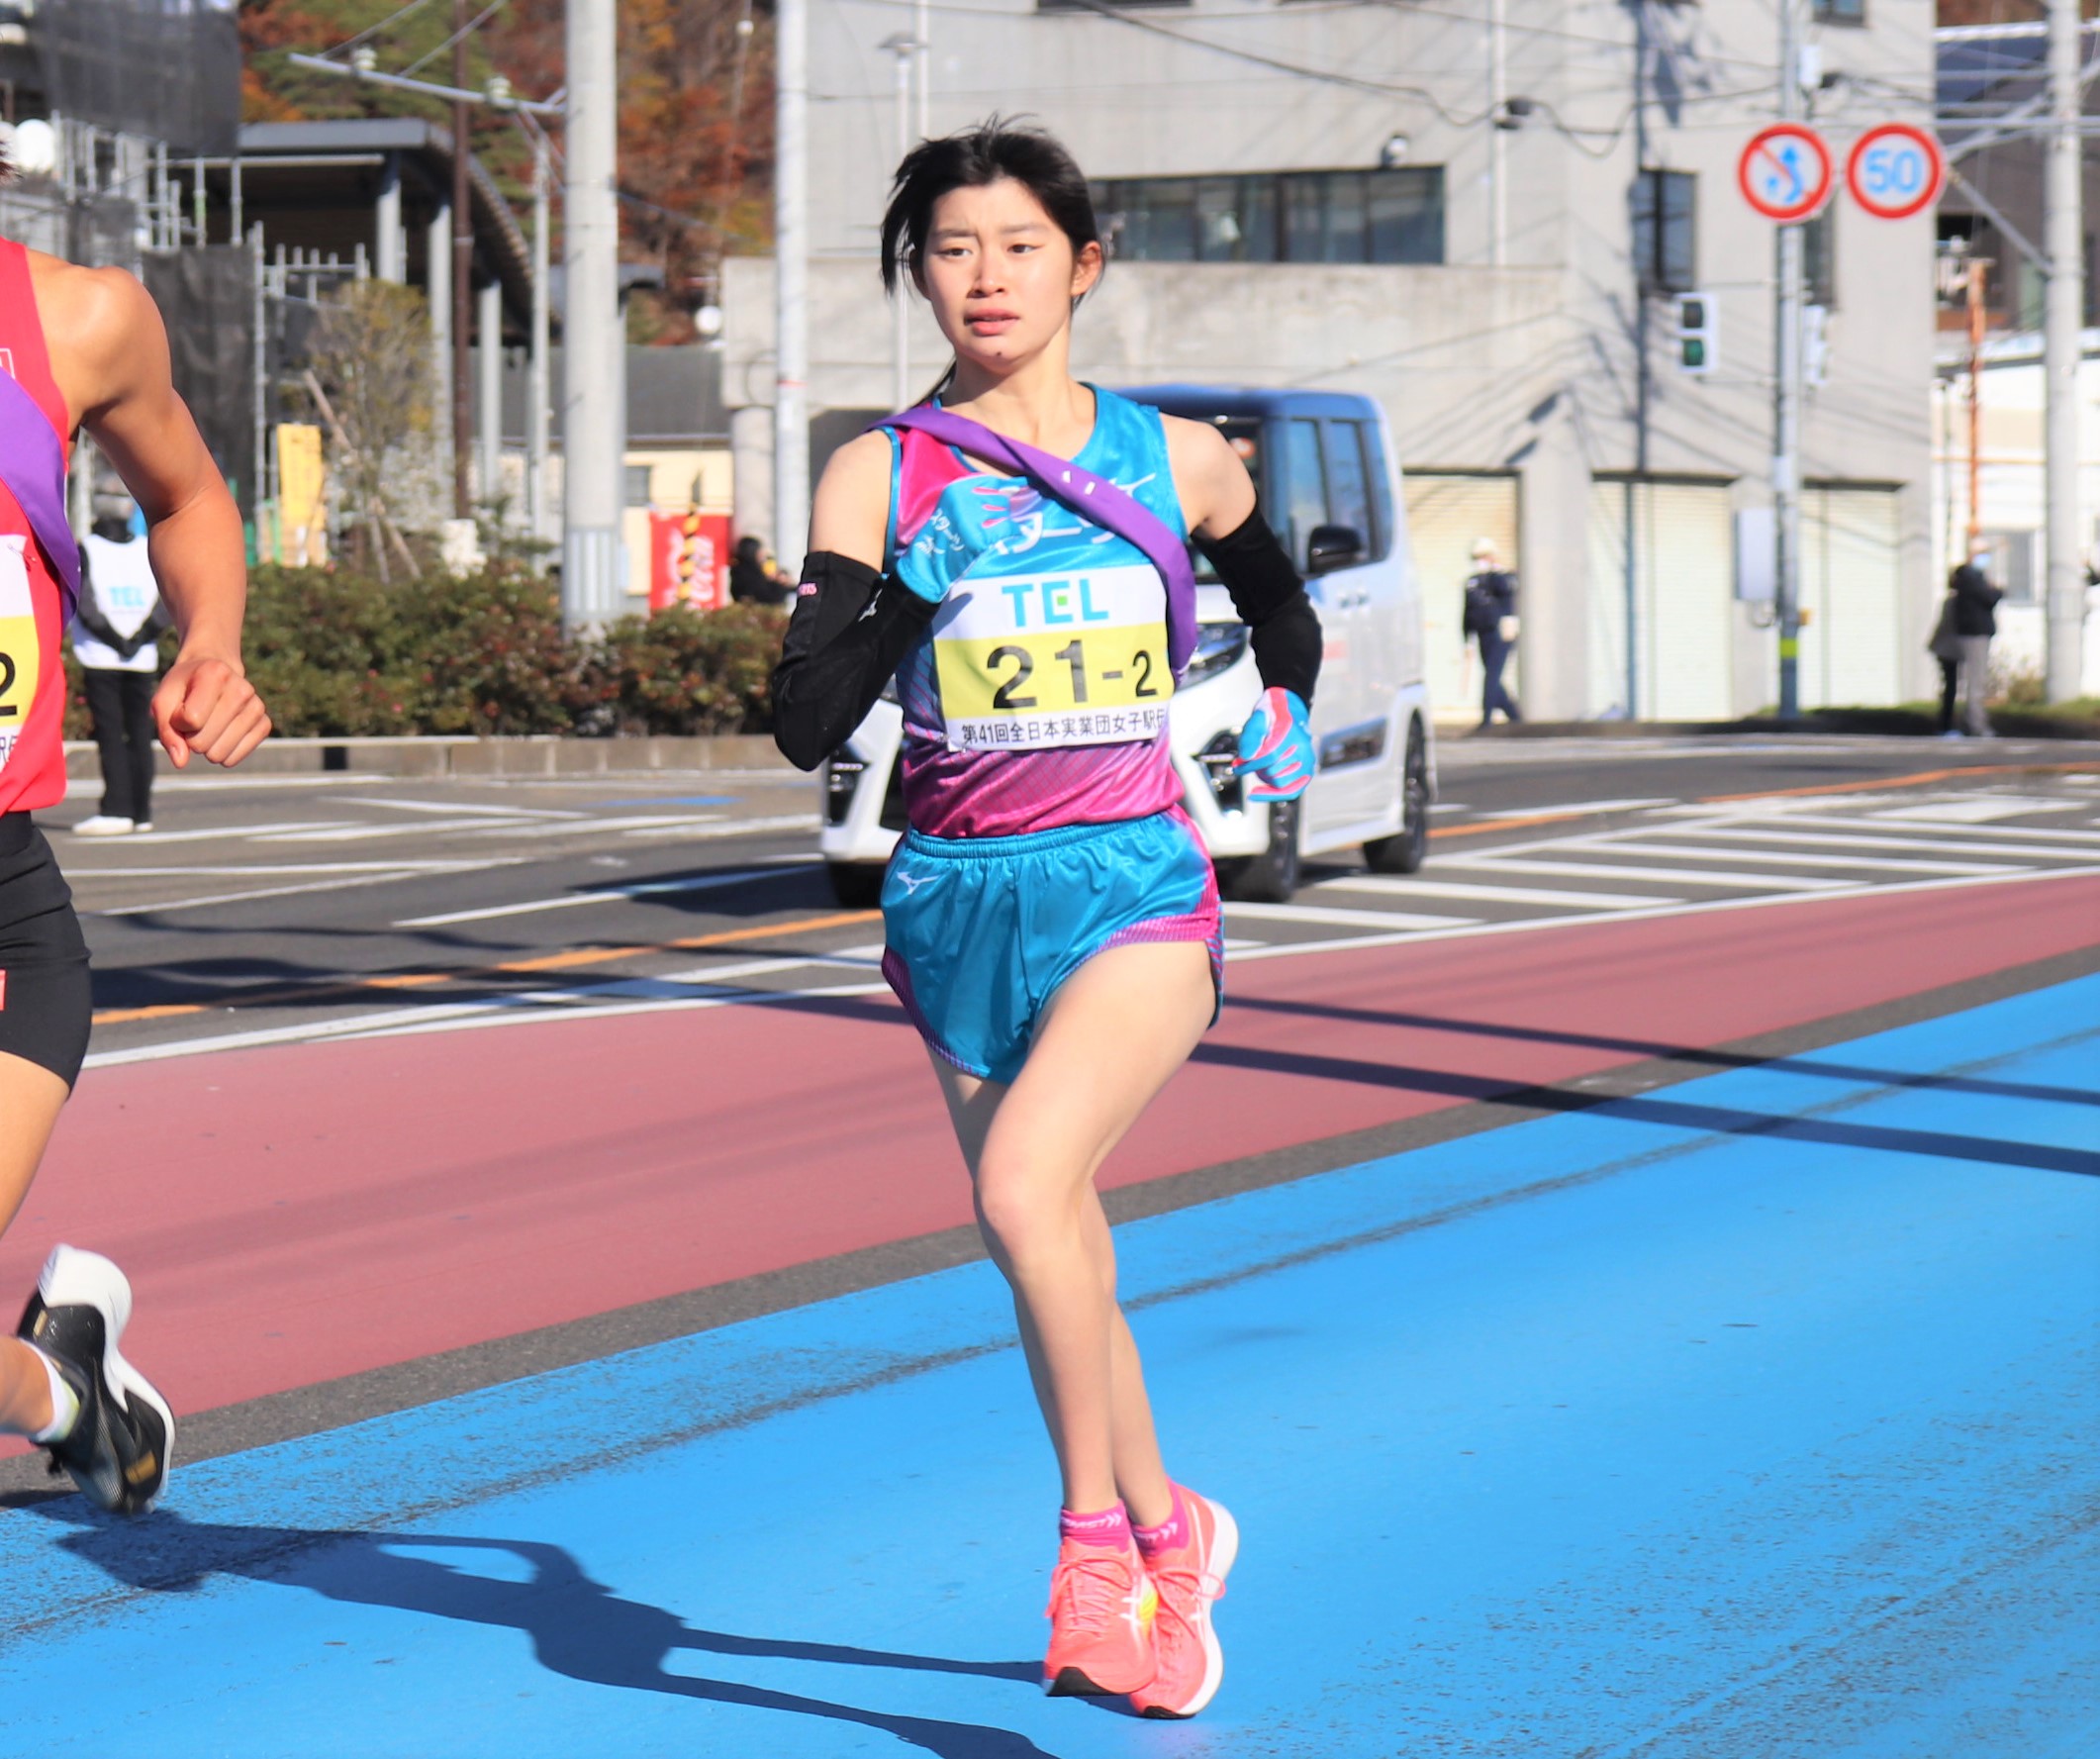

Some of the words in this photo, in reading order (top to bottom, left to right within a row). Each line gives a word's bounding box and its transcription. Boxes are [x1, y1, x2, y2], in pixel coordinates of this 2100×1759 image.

[1864, 148, 1923, 193] 50
[109, 586, 145, 607] TEL
[1001, 578, 1109, 628] TEL
[987, 638, 1159, 710] 21-2
